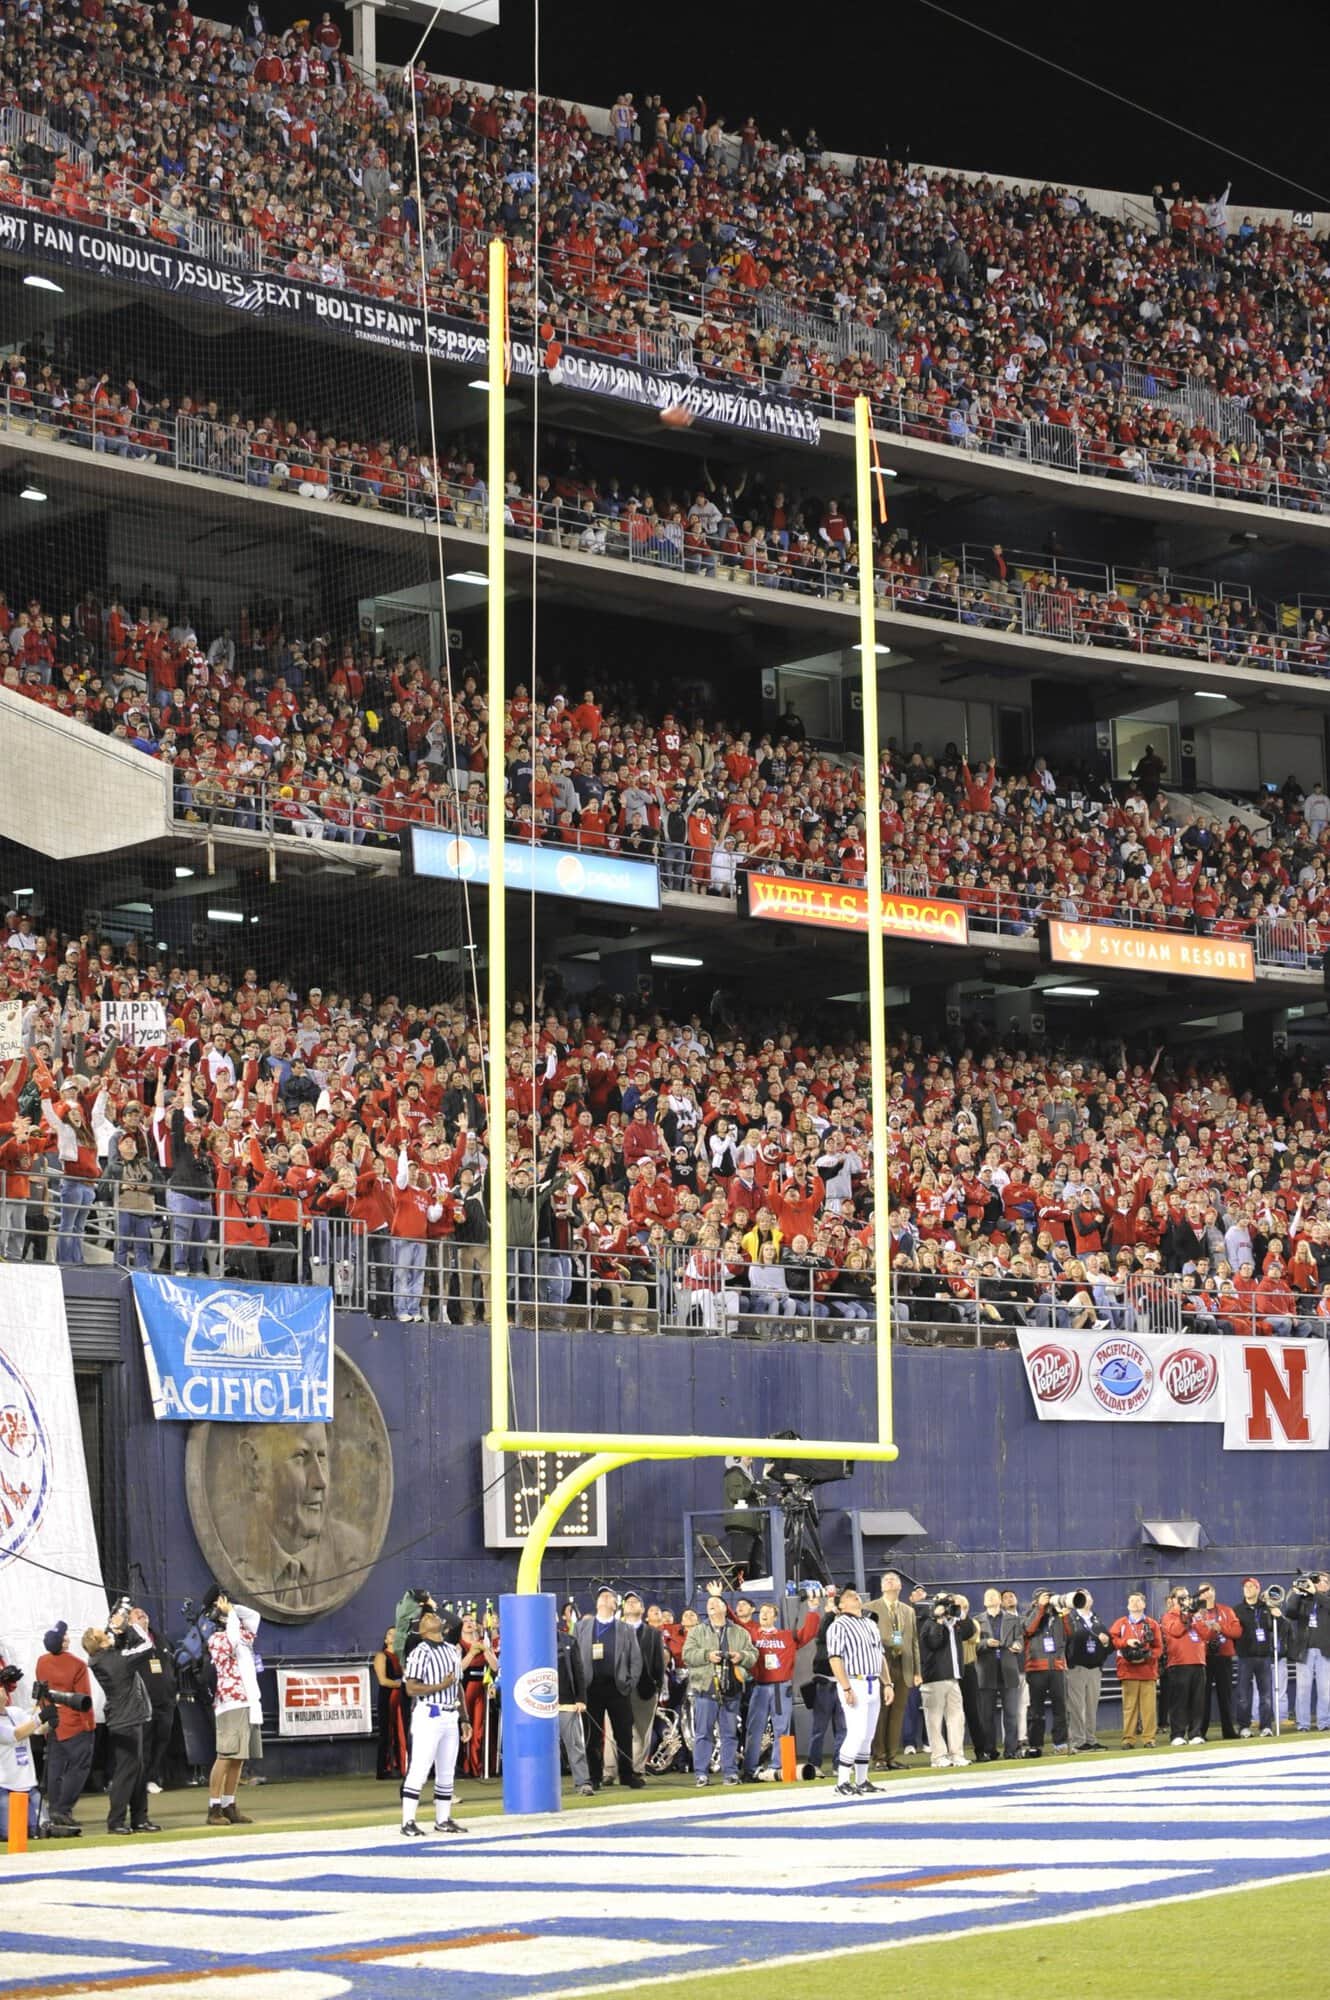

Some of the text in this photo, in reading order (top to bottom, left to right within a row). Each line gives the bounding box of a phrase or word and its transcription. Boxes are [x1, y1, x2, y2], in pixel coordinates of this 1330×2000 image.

[1293, 213, 1312, 226] 44
[0, 214, 28, 240] RT
[33, 222, 74, 254] FAN
[79, 235, 172, 278] CONDUCT
[252, 280, 302, 310] TEXT
[306, 291, 421, 337] "BOLTSFAN"
[427, 326, 490, 354] <space
[560, 354, 642, 393] OCATION
[753, 882, 961, 937] WELLS ARGO
[1099, 936, 1248, 969] SYCUAN RESORT
[105, 1002, 159, 1022] HAPPY
[1031, 1358, 1071, 1395] Pepper
[1044, 1353, 1061, 1369] Dr
[1181, 1356, 1198, 1376] Dr
[1172, 1361, 1208, 1397] Pepper
[1242, 1344, 1312, 1443] N
[1093, 1382, 1126, 1411] HOLIDAY
[285, 1675, 360, 1707] ESPN
